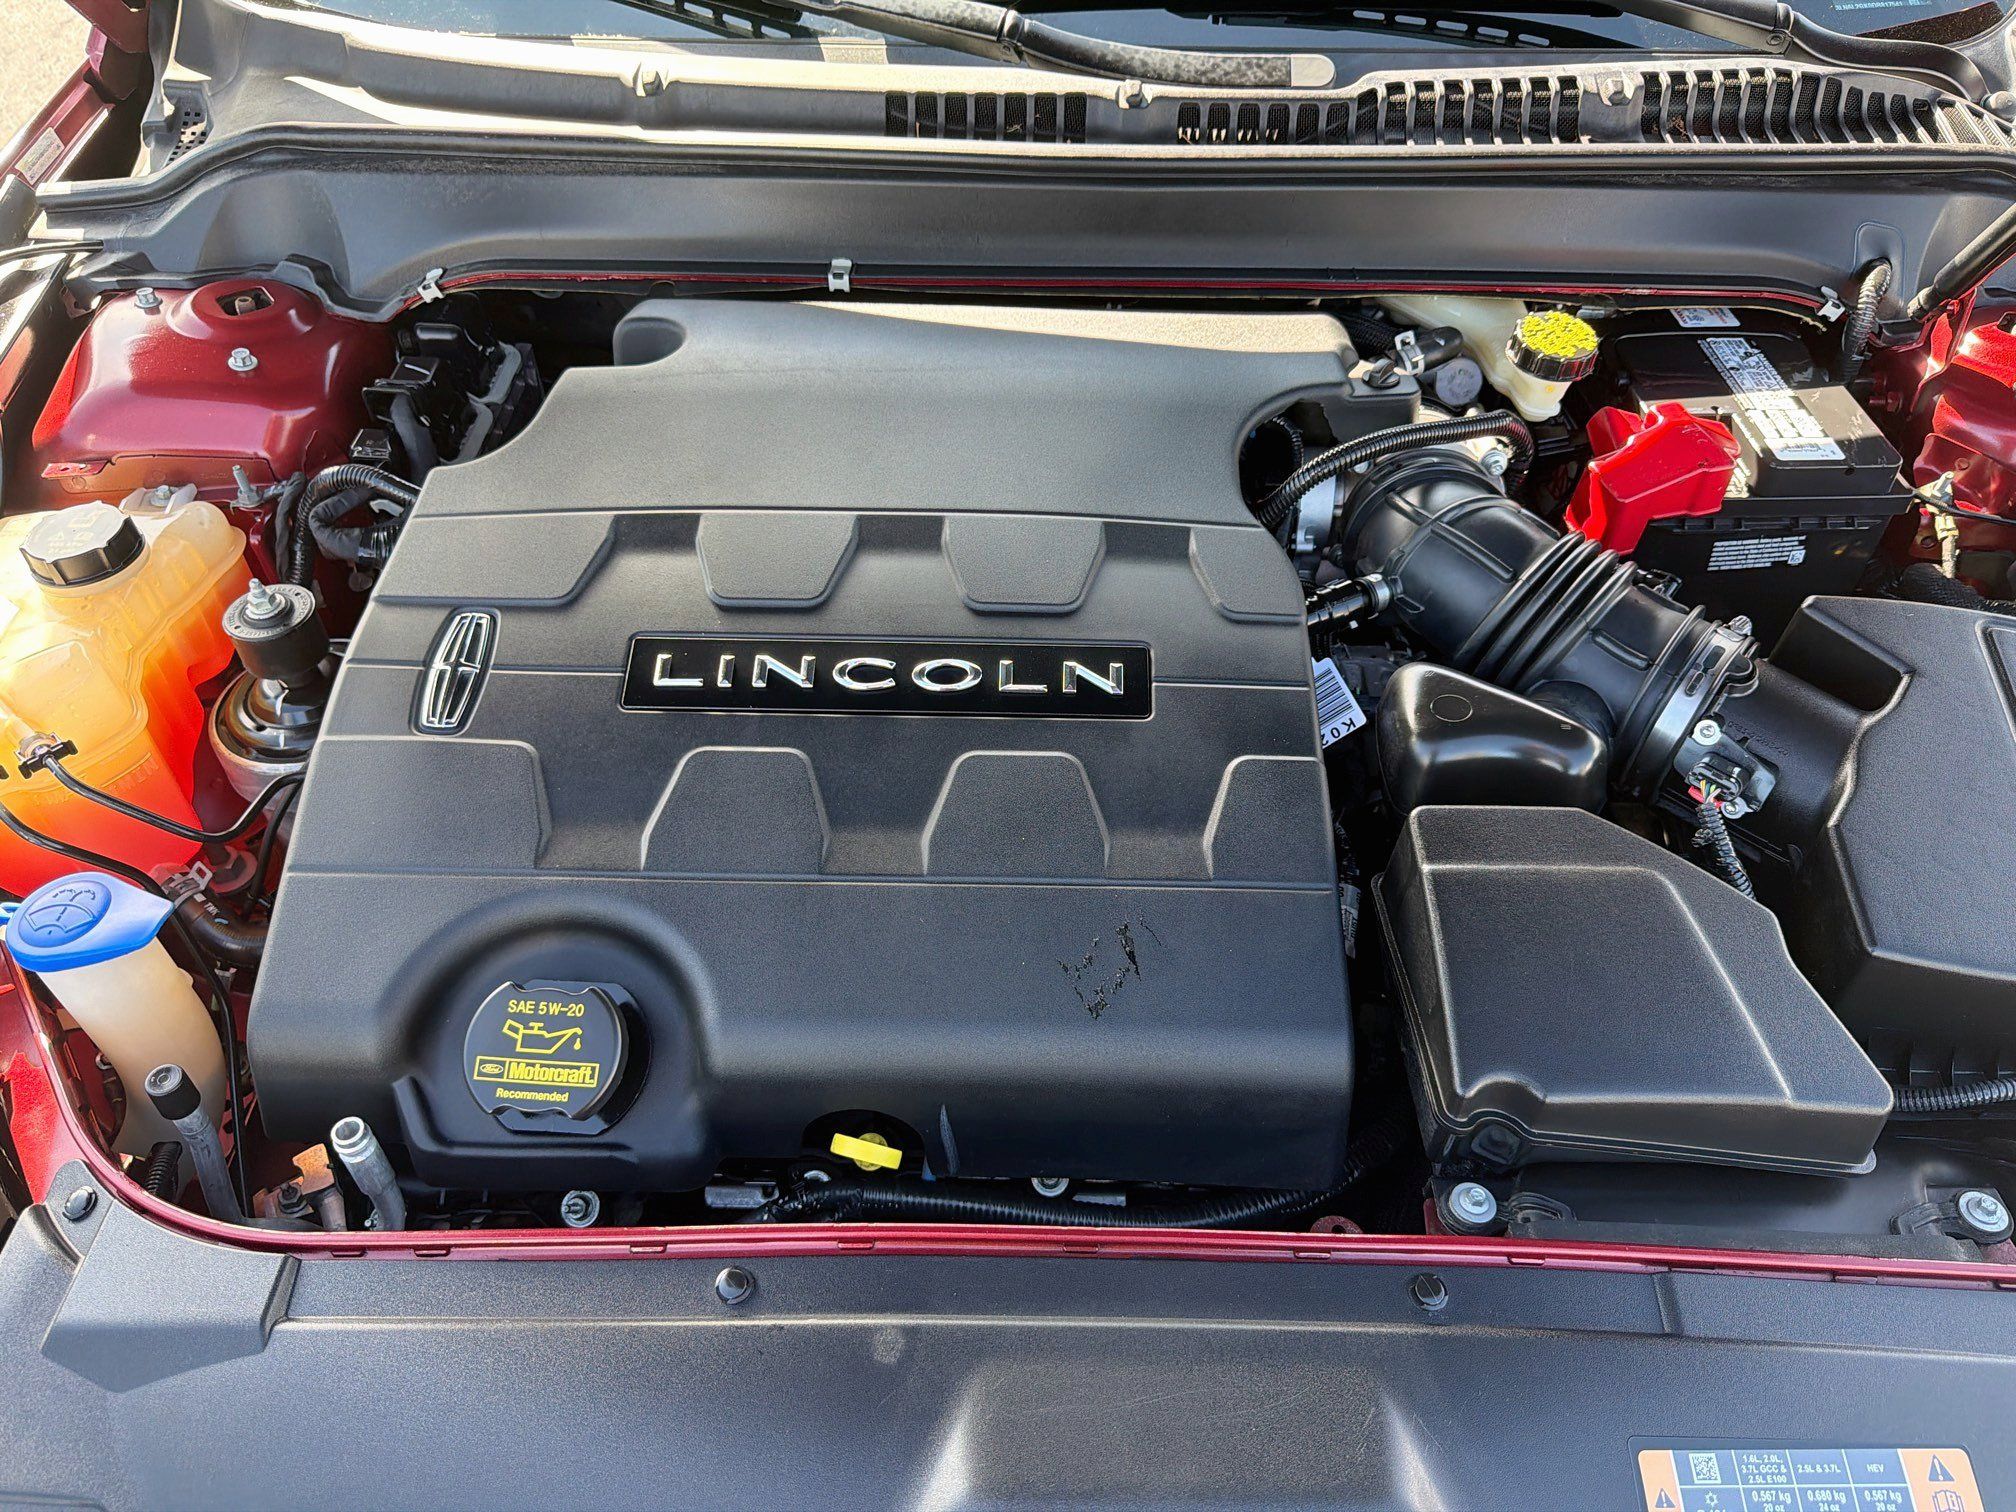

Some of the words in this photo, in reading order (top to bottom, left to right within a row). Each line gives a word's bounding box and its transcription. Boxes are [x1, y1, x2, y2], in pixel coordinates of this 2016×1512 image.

[653, 653, 1124, 694] LINCOLN
[508, 1000, 535, 1014] SAE
[538, 1001, 585, 1017] 5W-20
[496, 1088, 569, 1102] Recommended
[1760, 1464, 1780, 1473] GCC
[1781, 1464, 1787, 1473] &
[1867, 1464, 1884, 1473] HEV
[1767, 1474, 1787, 1483] E100
[1752, 1490, 1777, 1502] 0.567
[1778, 1490, 1792, 1504] kg
[1807, 1490, 1832, 1501] 0.680
[1833, 1490, 1846, 1504] kg
[1864, 1490, 1888, 1501] 0.567
[1889, 1490, 1902, 1503] kg
[1763, 1503, 1774, 1512] 20
